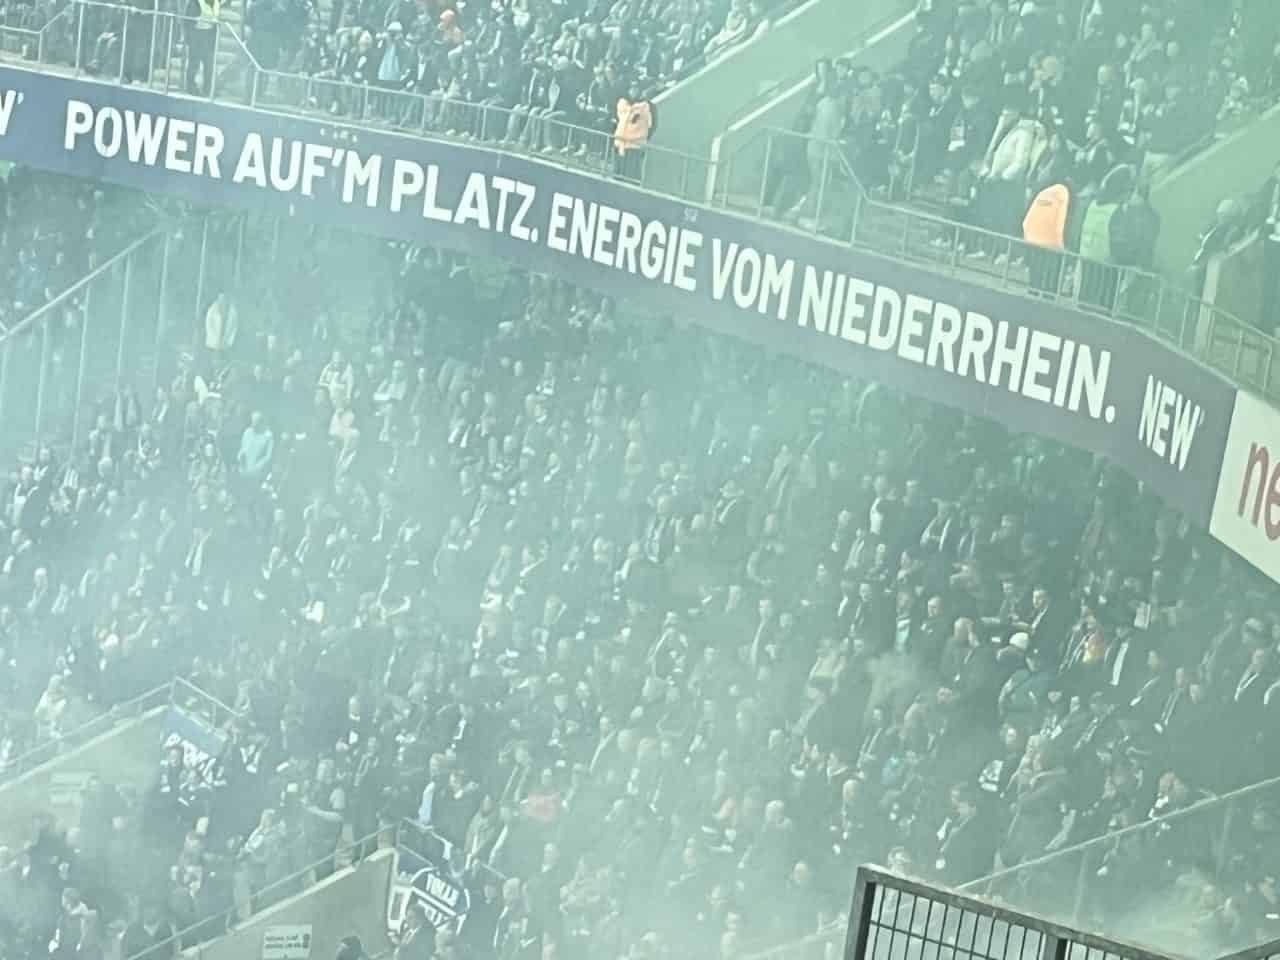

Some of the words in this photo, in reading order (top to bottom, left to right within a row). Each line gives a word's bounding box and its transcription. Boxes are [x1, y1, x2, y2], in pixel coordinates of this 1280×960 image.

[63, 99, 225, 178] POWER
[233, 132, 382, 207] AUF'M
[390, 159, 538, 243] PLATZ.
[547, 192, 704, 292] ENERGIE
[711, 238, 795, 320] VOM
[798, 264, 1116, 423] NIEDERRHEIN.
